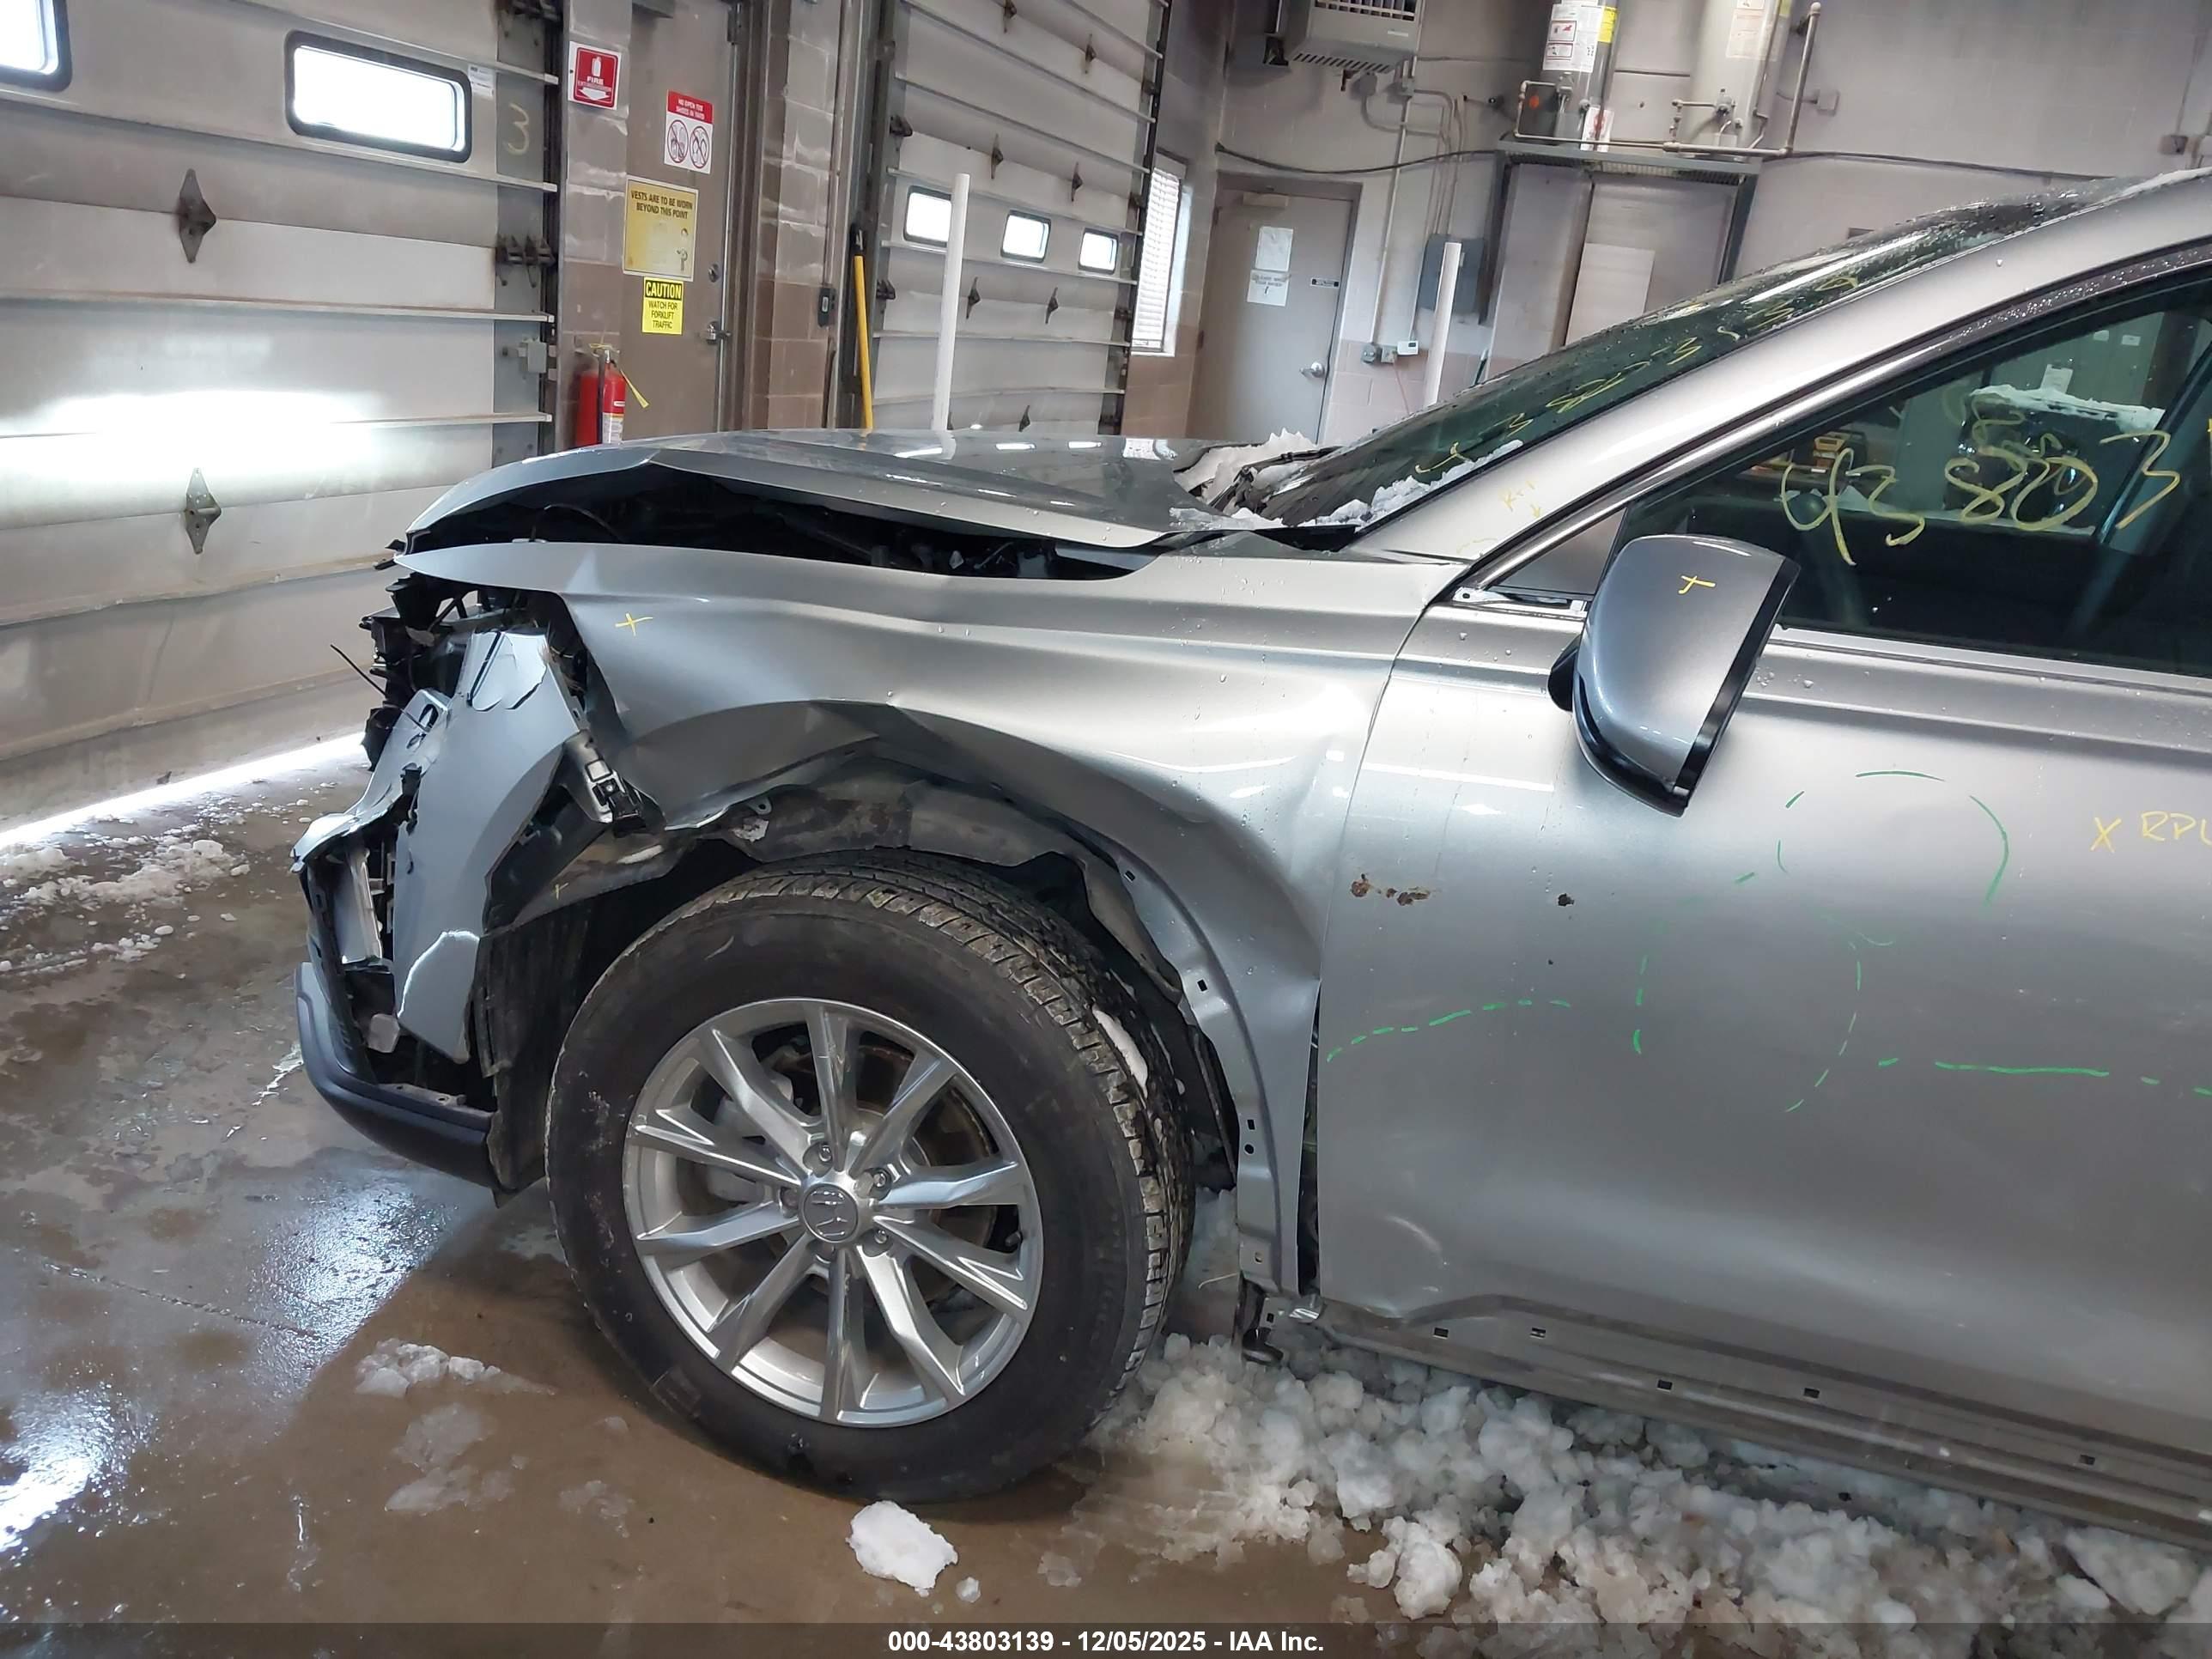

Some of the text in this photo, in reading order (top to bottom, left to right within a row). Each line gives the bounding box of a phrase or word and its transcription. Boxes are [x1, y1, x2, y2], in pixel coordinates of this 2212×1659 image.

[507, 102, 530, 155] 3
[631, 191, 693, 210] VESTS ARE TO BE WORN
[636, 203, 689, 220] BEYOND THIS POINT
[646, 281, 682, 300] CAUTION
[648, 301, 678, 310] WATCH FOR
[651, 310, 675, 319] FORKLIFT
[652, 319, 673, 330] TRAFFIC
